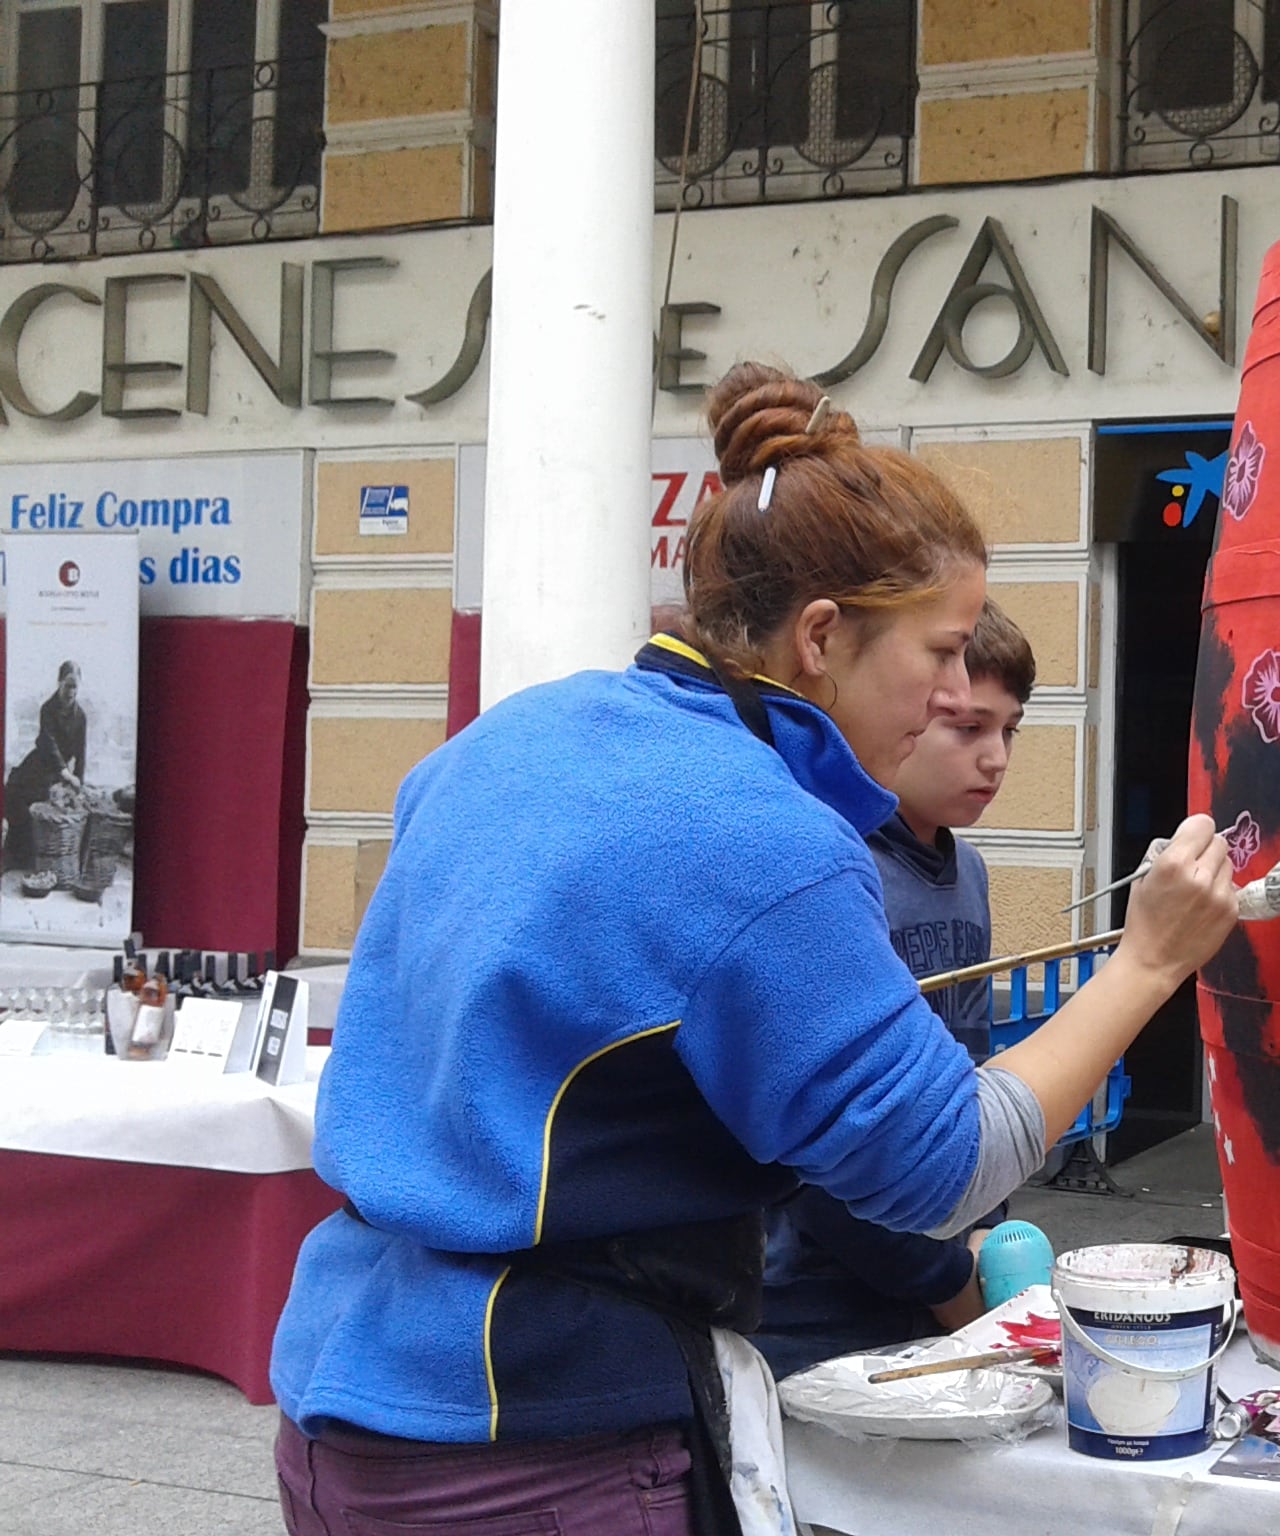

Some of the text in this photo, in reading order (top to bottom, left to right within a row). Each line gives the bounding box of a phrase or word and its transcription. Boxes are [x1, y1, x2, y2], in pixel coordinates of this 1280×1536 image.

[0, 257, 494, 426] CENES
[652, 300, 722, 394] E
[806, 194, 1238, 387] SAN
[11, 491, 232, 534] Feliz Compra
[169, 547, 241, 584] dias
[1093, 1312, 1171, 1323] ERIDANOUS
